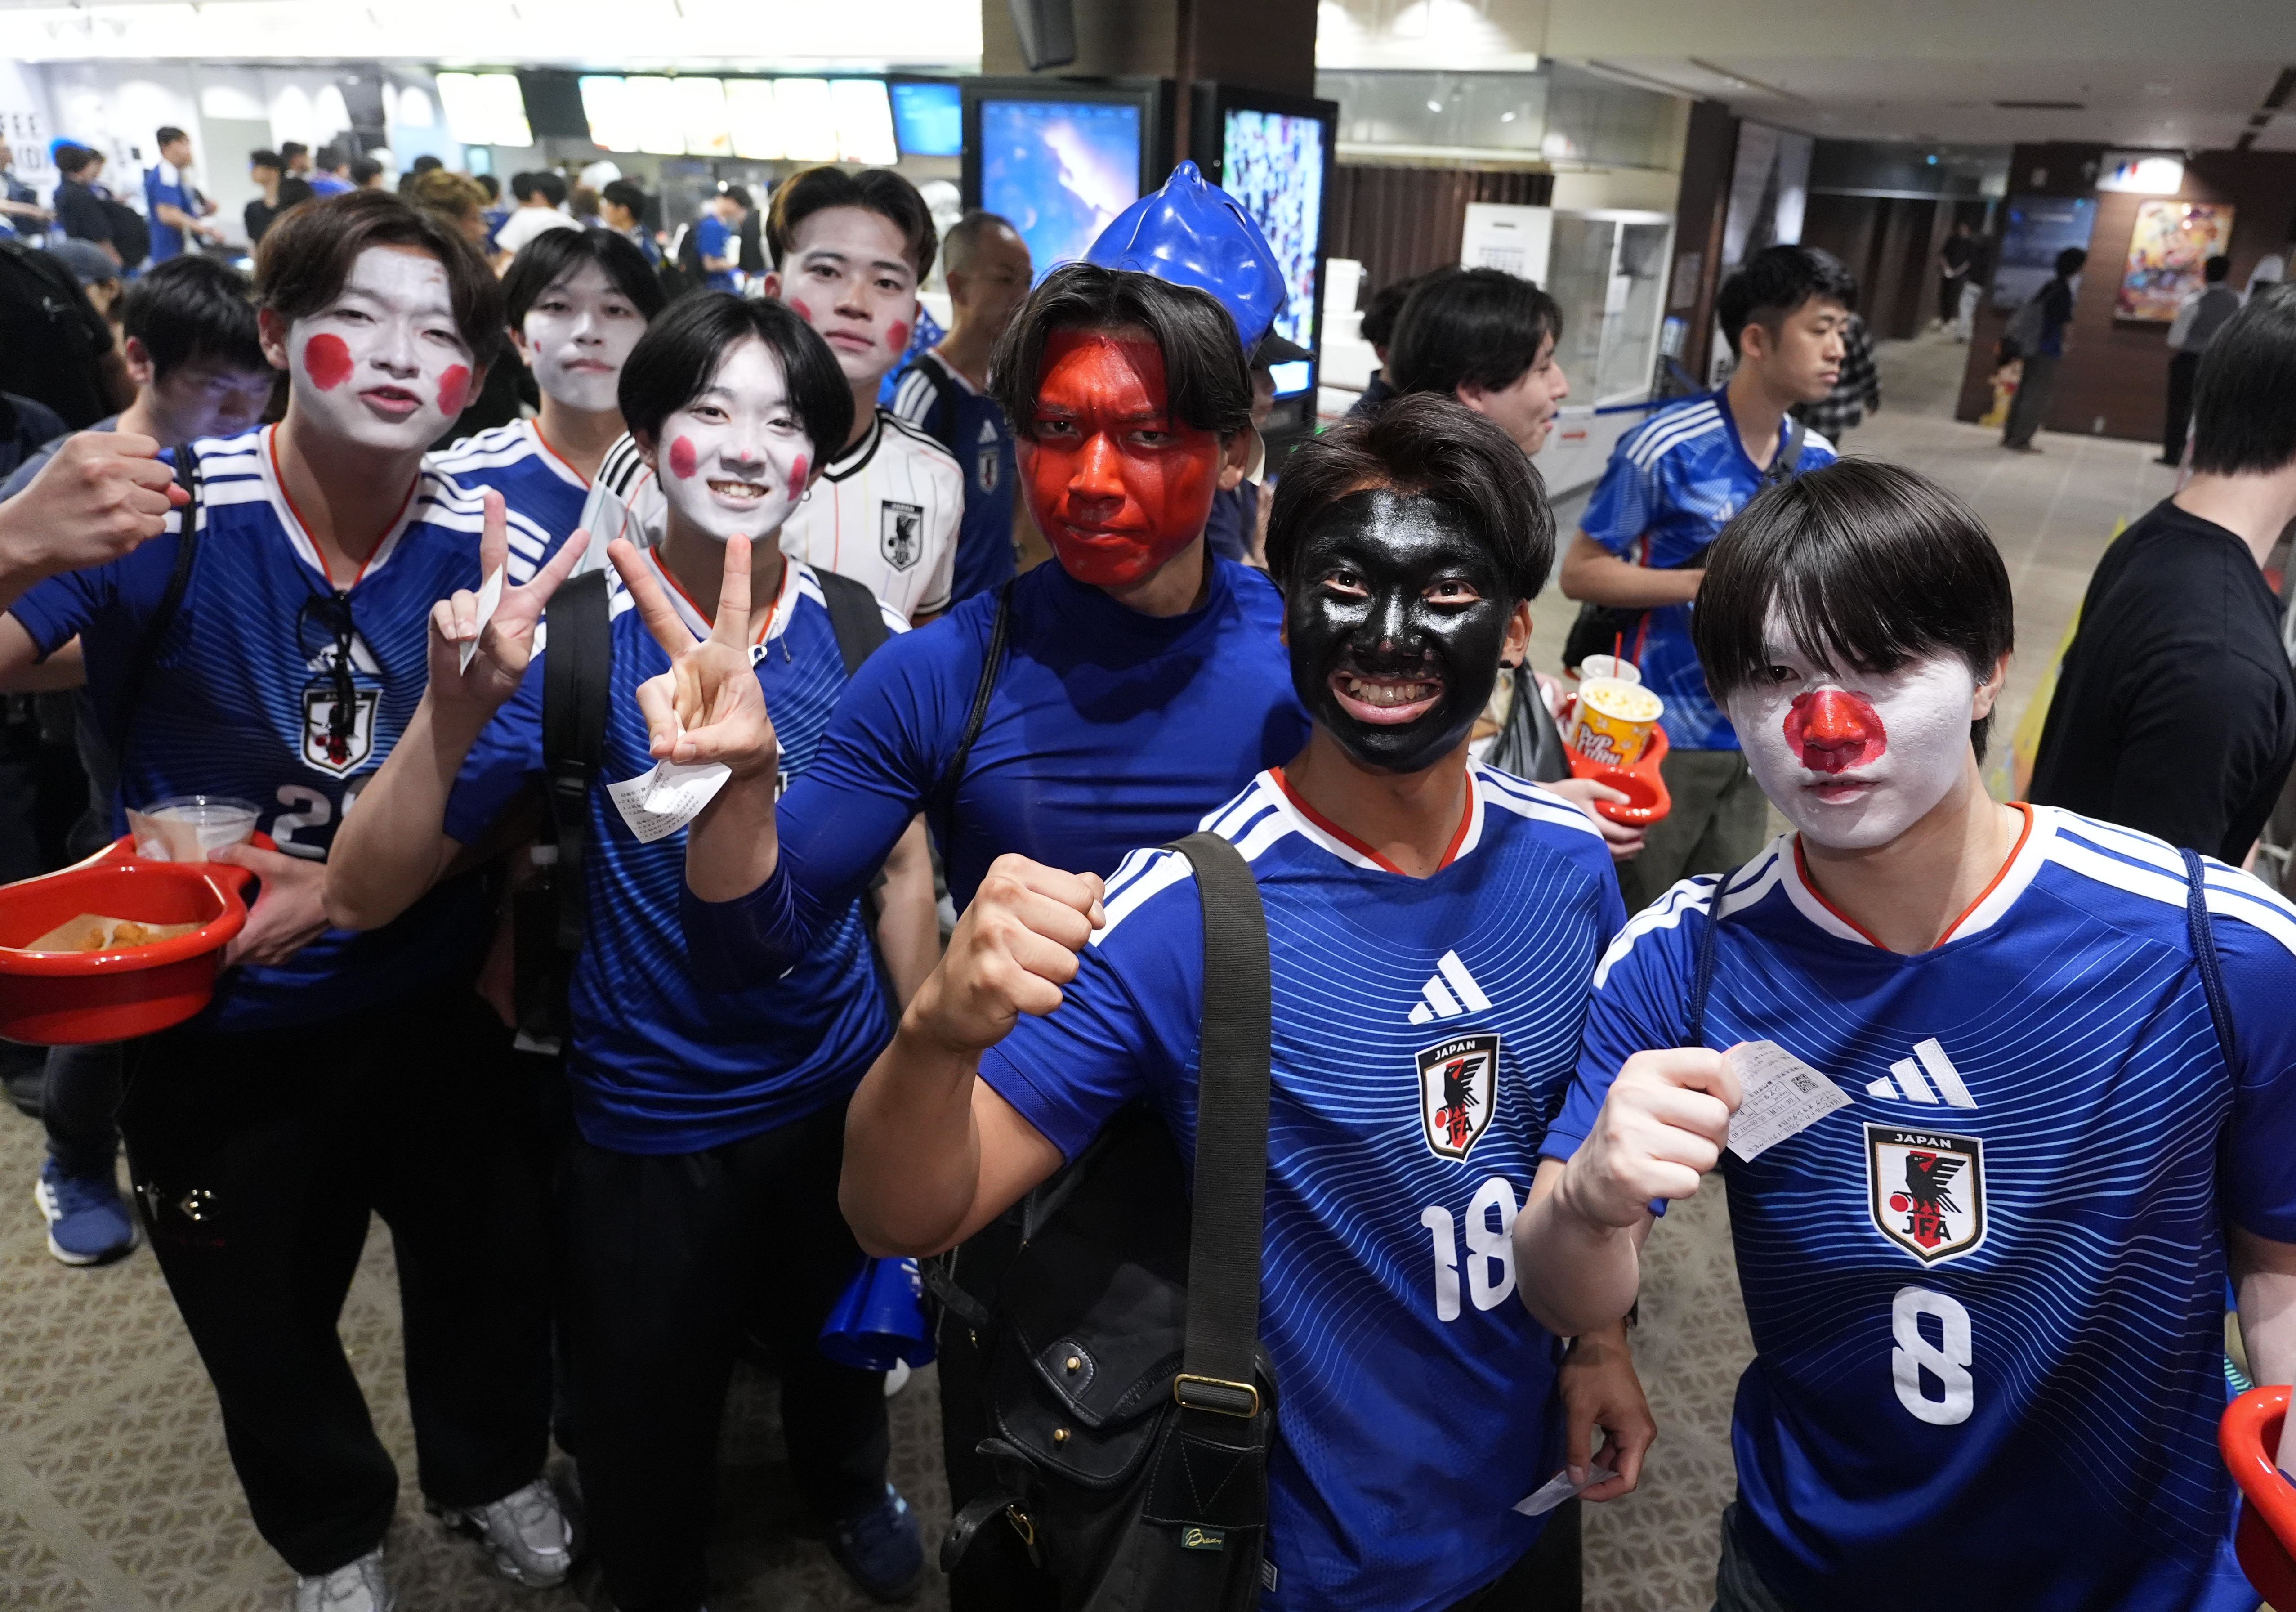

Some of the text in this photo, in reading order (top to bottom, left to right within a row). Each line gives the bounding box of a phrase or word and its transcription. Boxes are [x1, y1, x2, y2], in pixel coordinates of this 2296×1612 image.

[271, 775, 372, 859] 2
[1434, 1040, 1476, 1061] JAPAN
[1446, 1116, 1473, 1146] JFA
[1894, 1133, 1952, 1149] JAPAN
[1902, 1216, 1952, 1241] JFA
[1420, 1177, 1519, 1322] 18
[1891, 1286, 1974, 1426] 8
